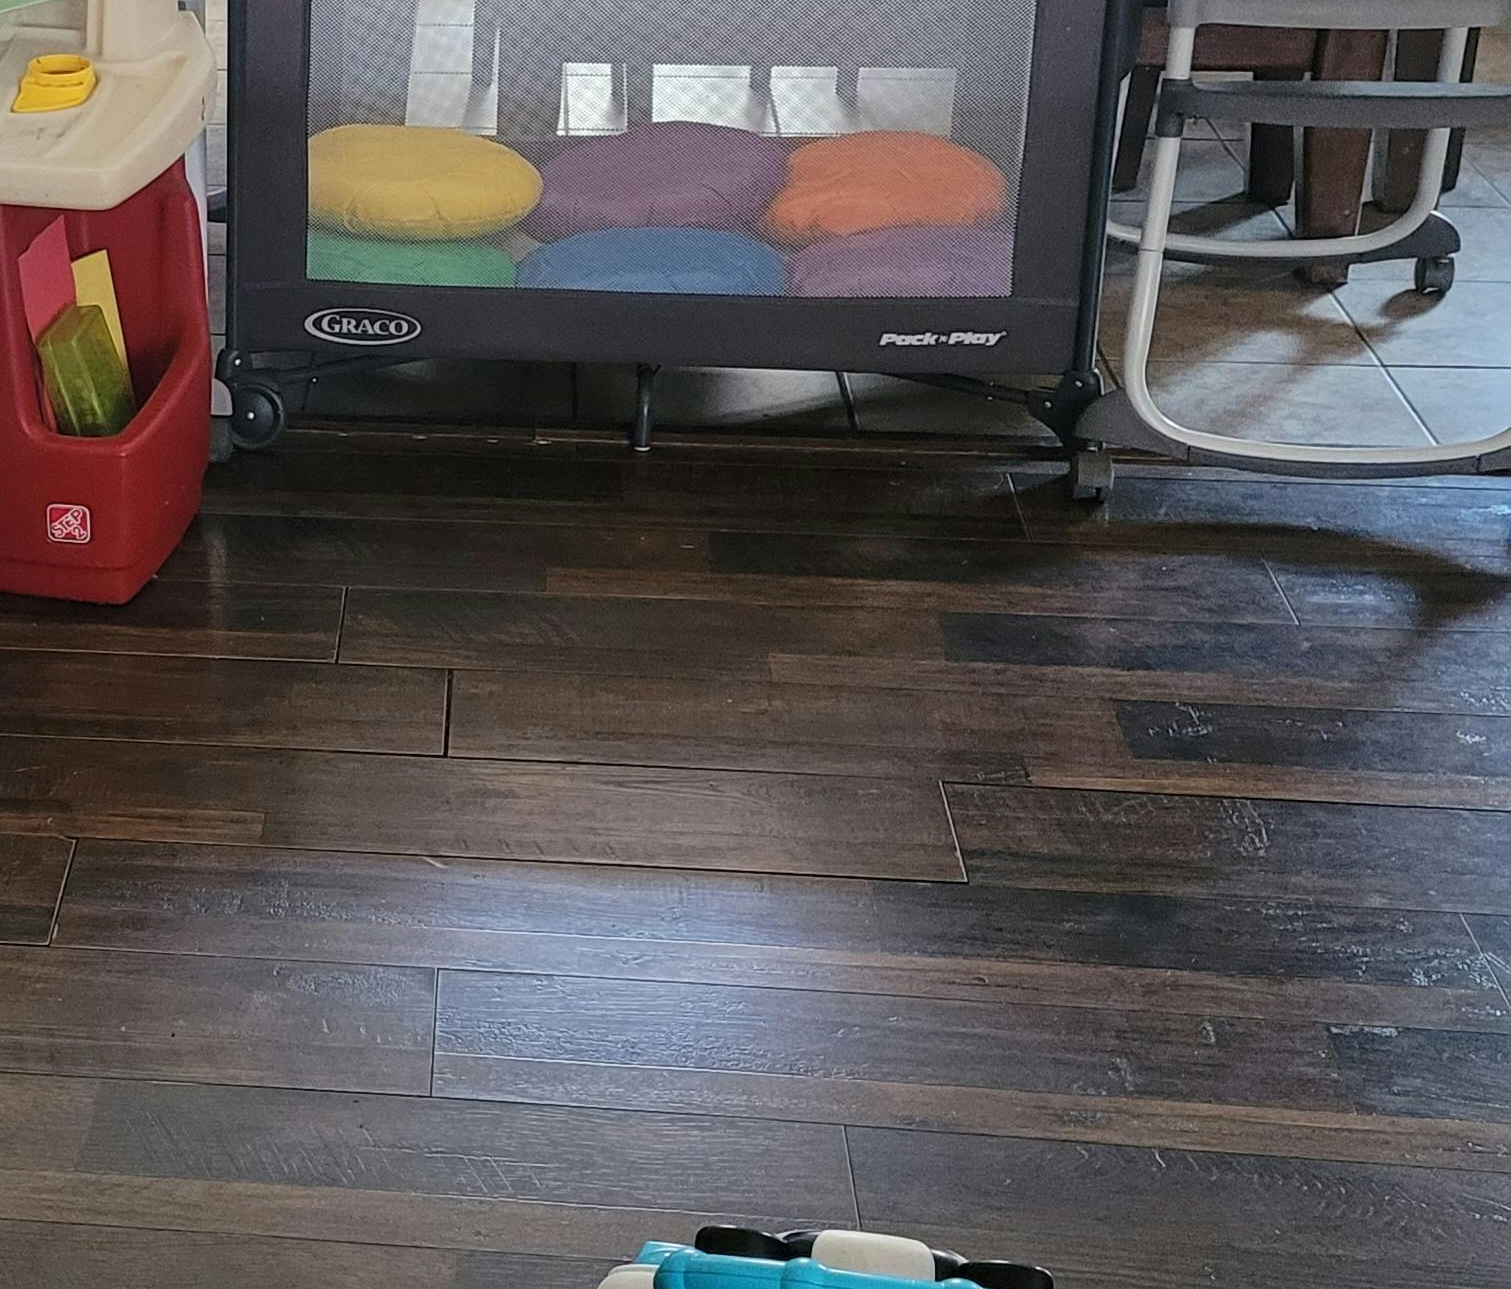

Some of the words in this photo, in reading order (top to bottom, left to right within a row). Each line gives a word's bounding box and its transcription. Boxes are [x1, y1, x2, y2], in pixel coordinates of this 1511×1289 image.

[321, 314, 409, 336] GRACO
[879, 332, 939, 346] Pack
[948, 331, 1003, 346] Play
[50, 508, 84, 539] STEP
[72, 524, 87, 540] 2
